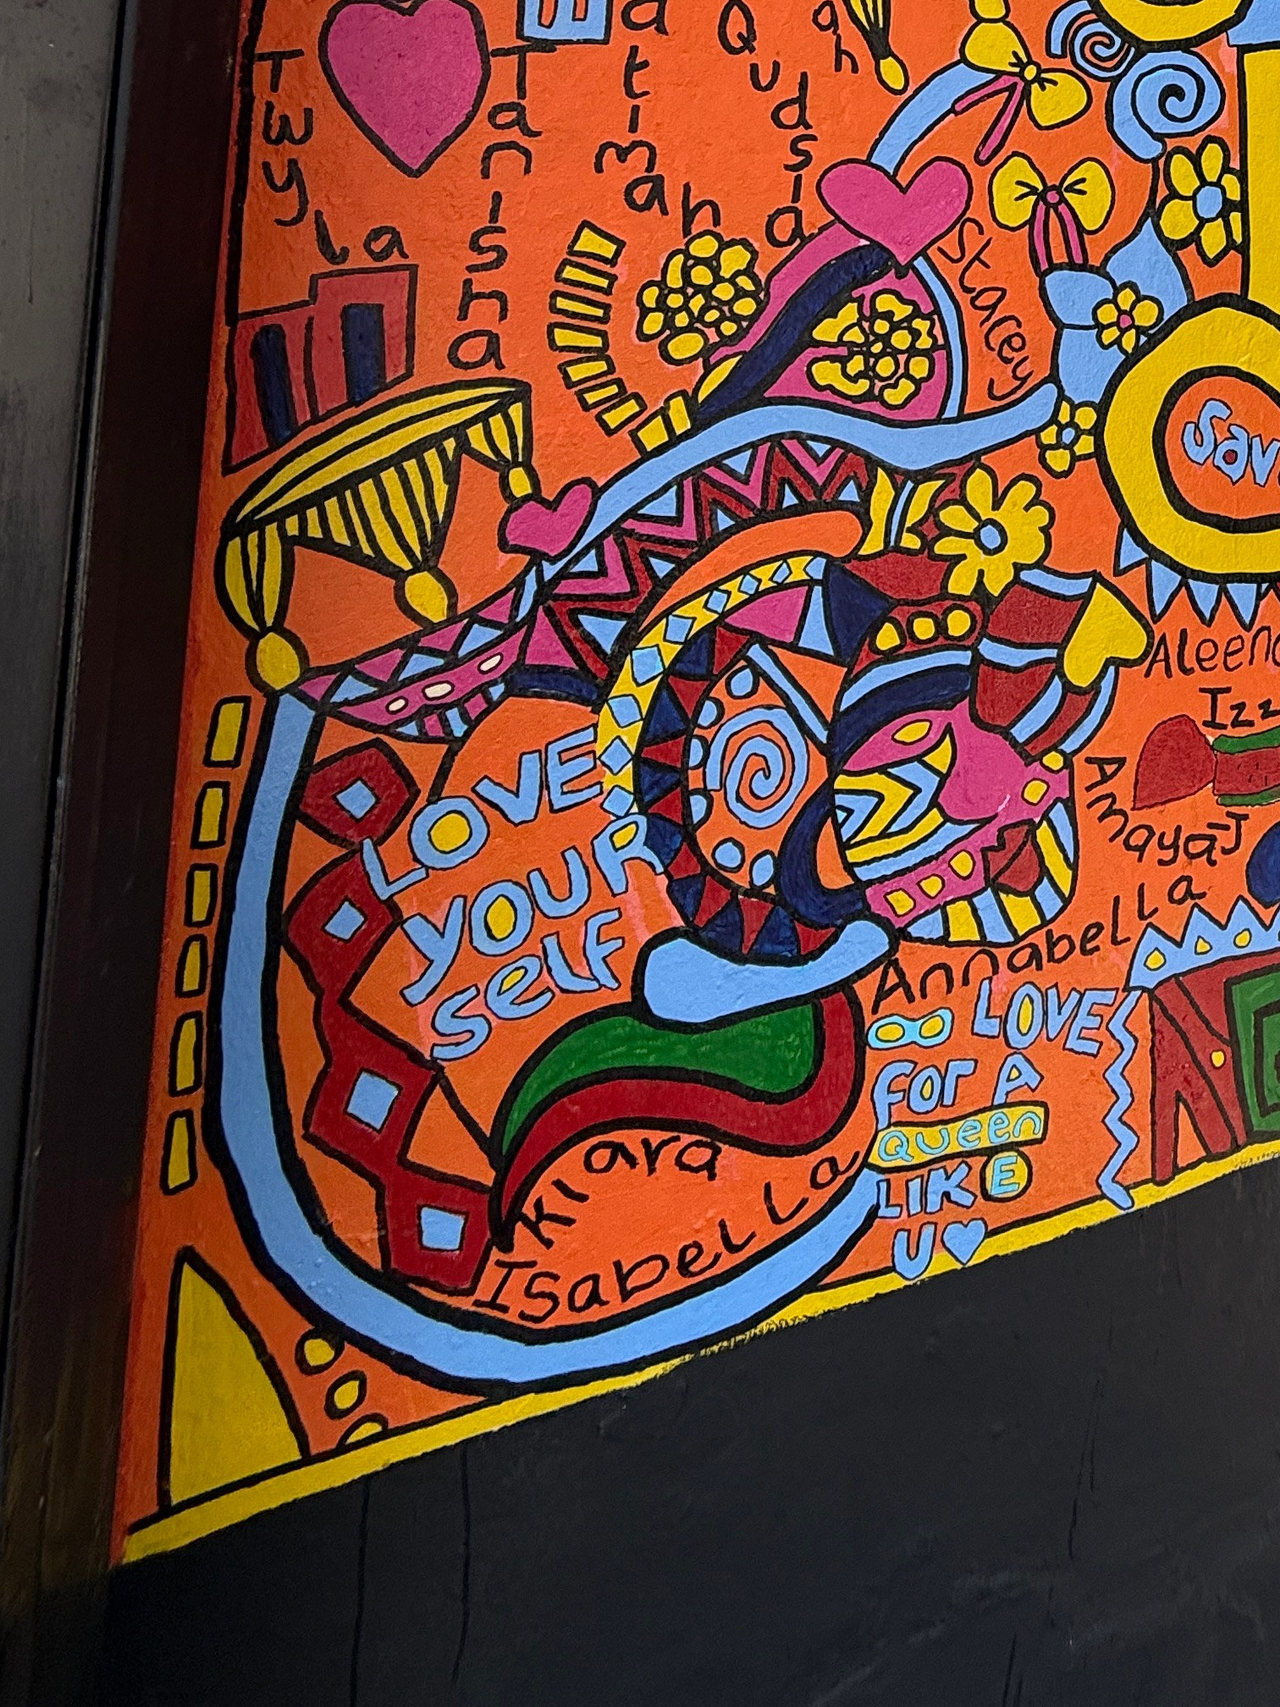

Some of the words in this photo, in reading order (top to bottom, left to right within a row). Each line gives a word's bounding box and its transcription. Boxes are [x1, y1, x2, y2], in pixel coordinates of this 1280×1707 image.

[255, 49, 409, 265] Twyla
[446, 44, 556, 370] Tanisha
[937, 217, 1034, 401] Stacey
[361, 724, 604, 900] LOVE
[872, 874, 1207, 1014] Annabella
[971, 978, 1119, 1055] LOVE
[876, 1151, 1021, 1218] LIKE
[892, 1222, 935, 1280] U
